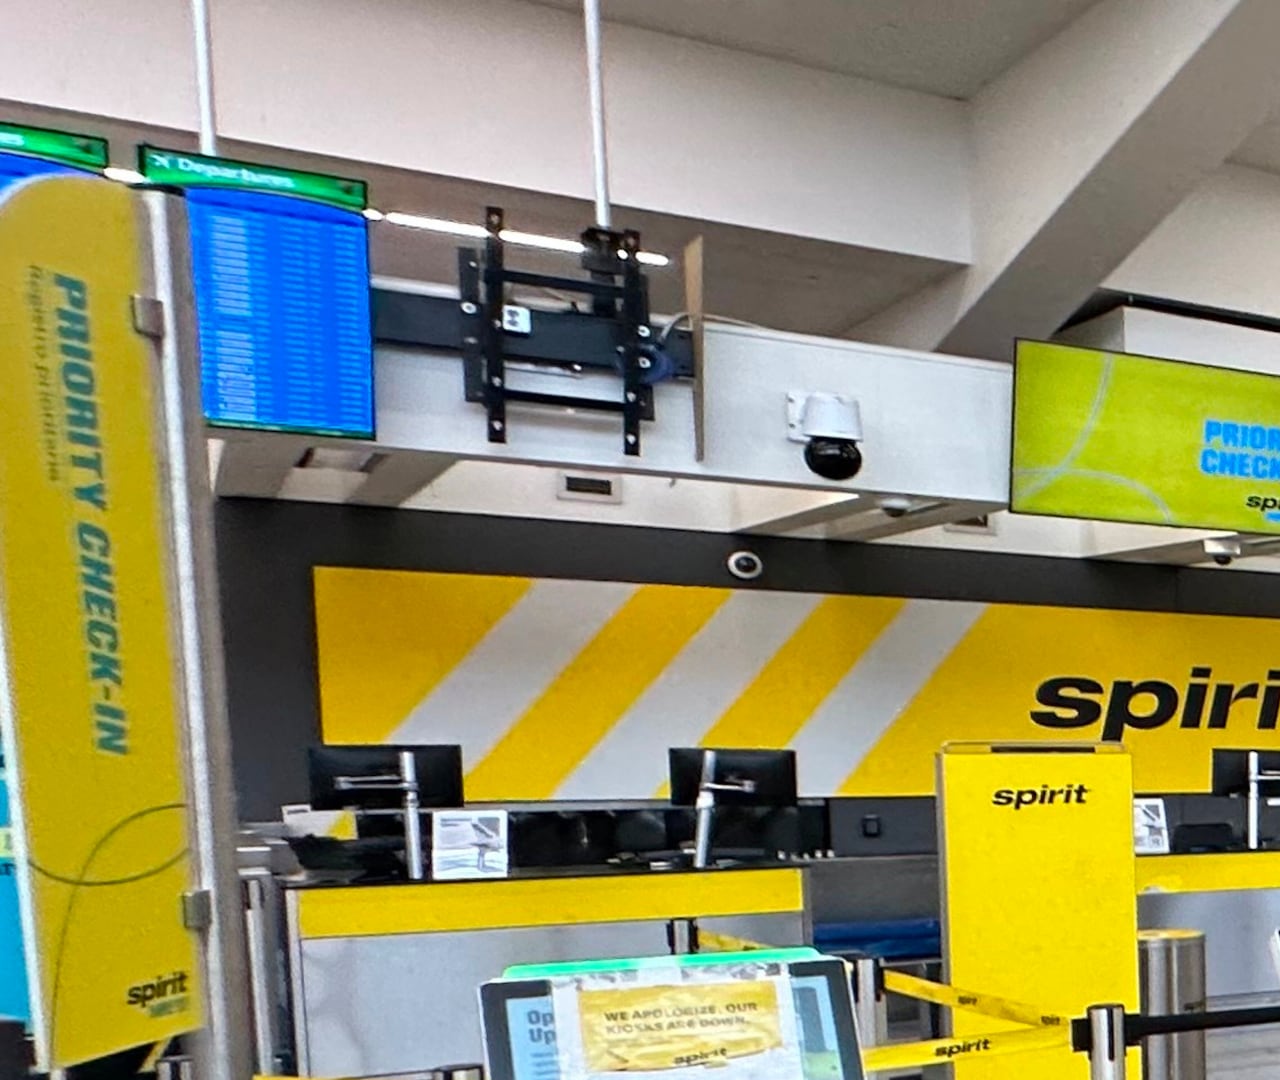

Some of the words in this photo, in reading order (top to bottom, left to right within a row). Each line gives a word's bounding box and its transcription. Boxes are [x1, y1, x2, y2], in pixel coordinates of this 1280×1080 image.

[178, 157, 296, 189] Departures
[54, 272, 108, 511] PRIORITY
[76, 521, 129, 756] CHECK-IN
[991, 783, 1089, 811] spirit
[127, 972, 189, 1008] spirit
[604, 1011, 629, 1022] WE
[725, 1001, 758, 1014] OUR
[935, 1037, 993, 1058] spirit
